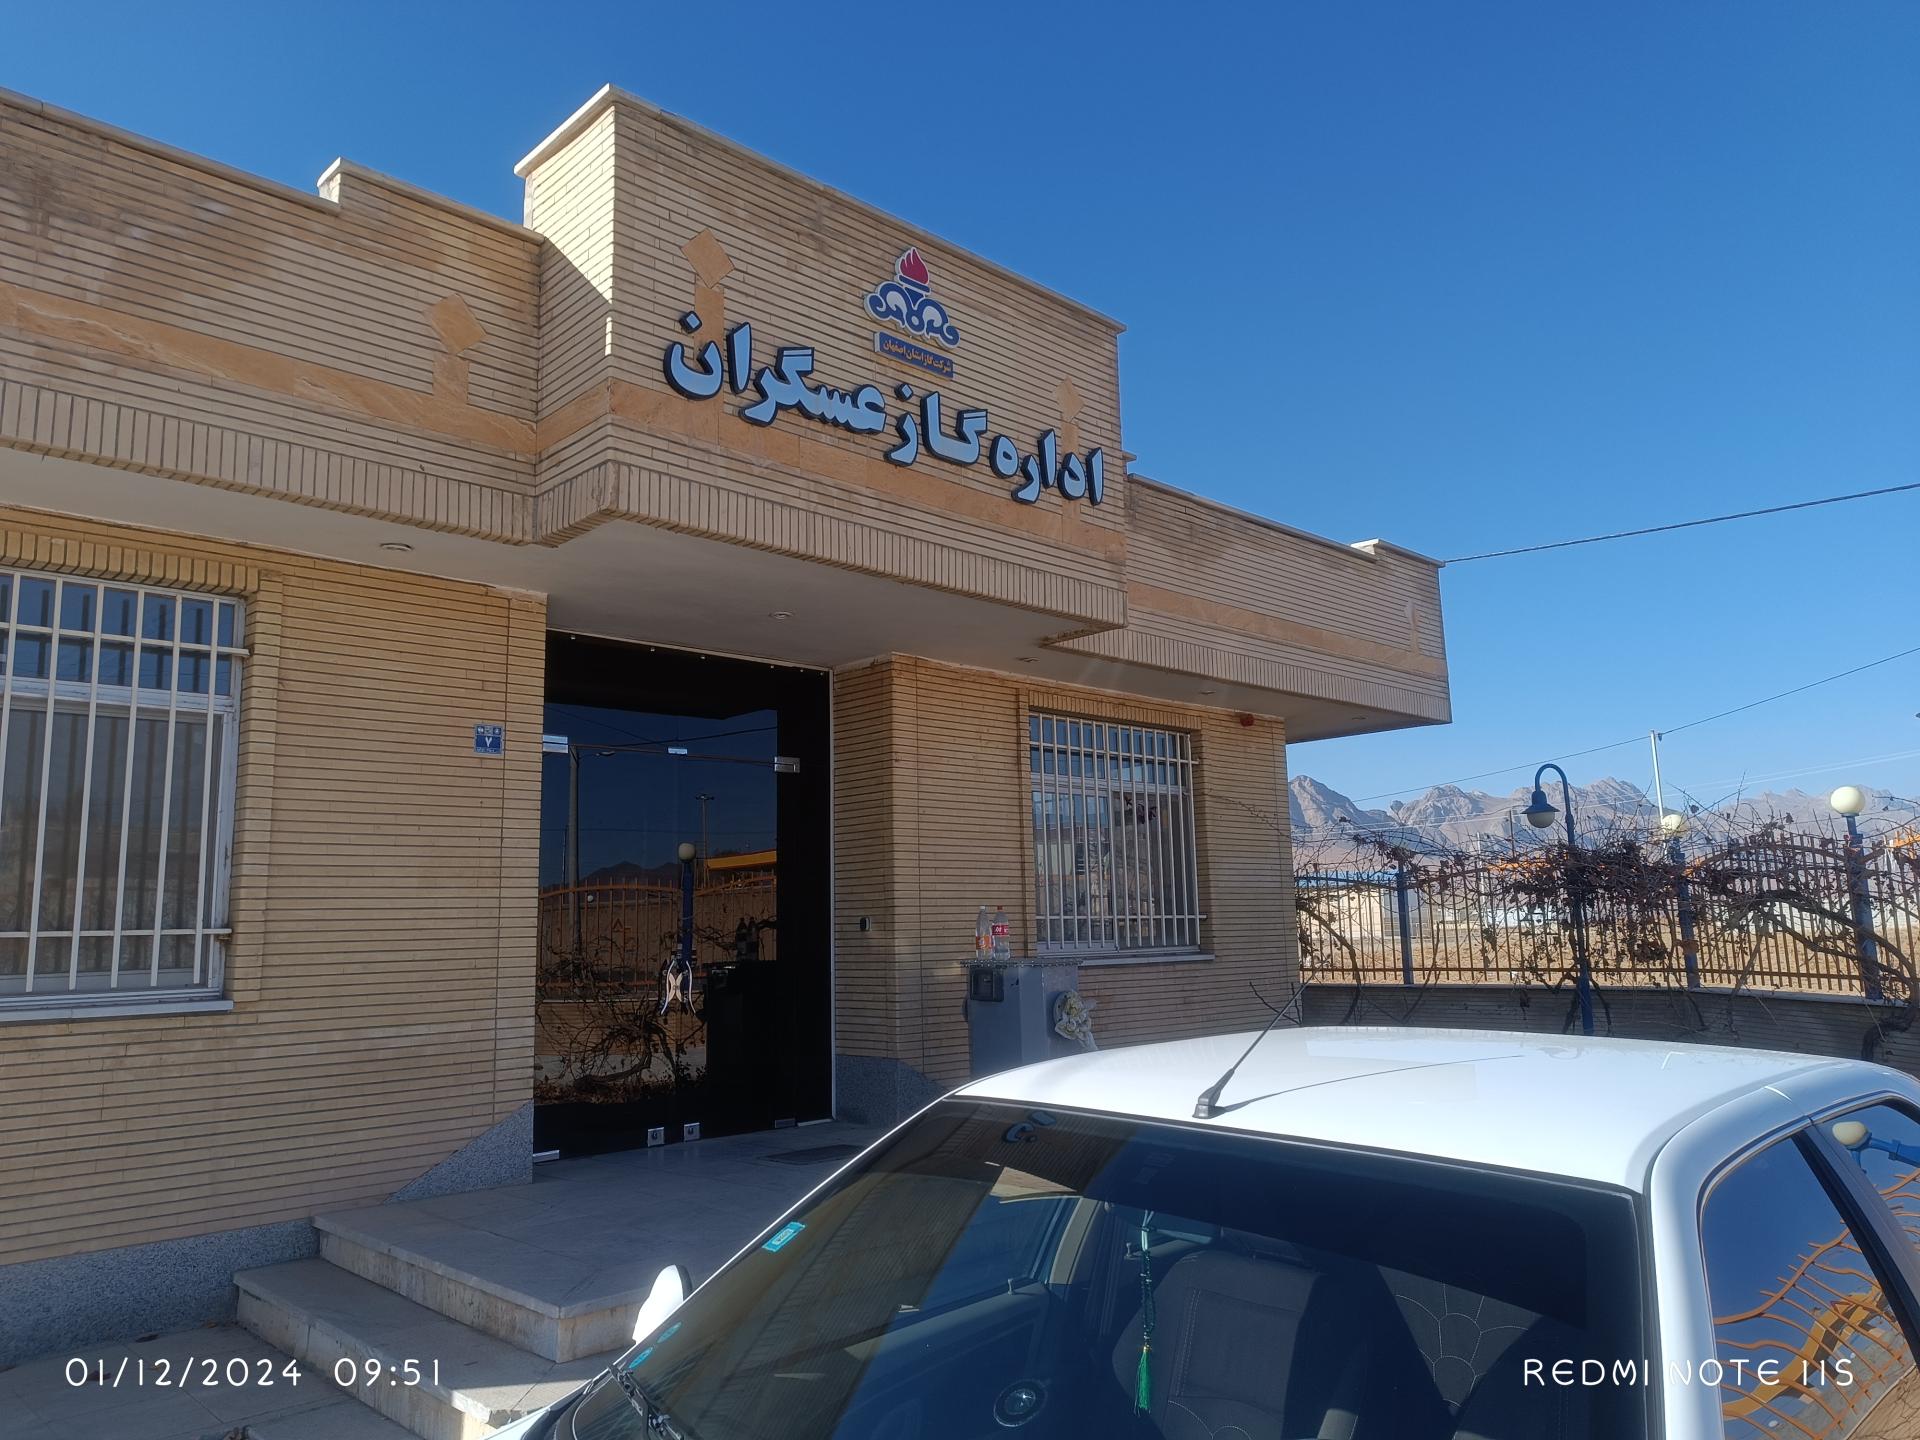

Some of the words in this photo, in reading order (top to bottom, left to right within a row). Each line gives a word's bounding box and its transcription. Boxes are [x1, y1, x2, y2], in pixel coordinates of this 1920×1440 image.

[883, 340, 906, 355] اصفهان
[906, 348, 923, 361] استان
[932, 359, 952, 373] شرکت
[663, 310, 887, 434] عسگران
[884, 382, 988, 467] گاز
[989, 428, 1104, 506] اداره
